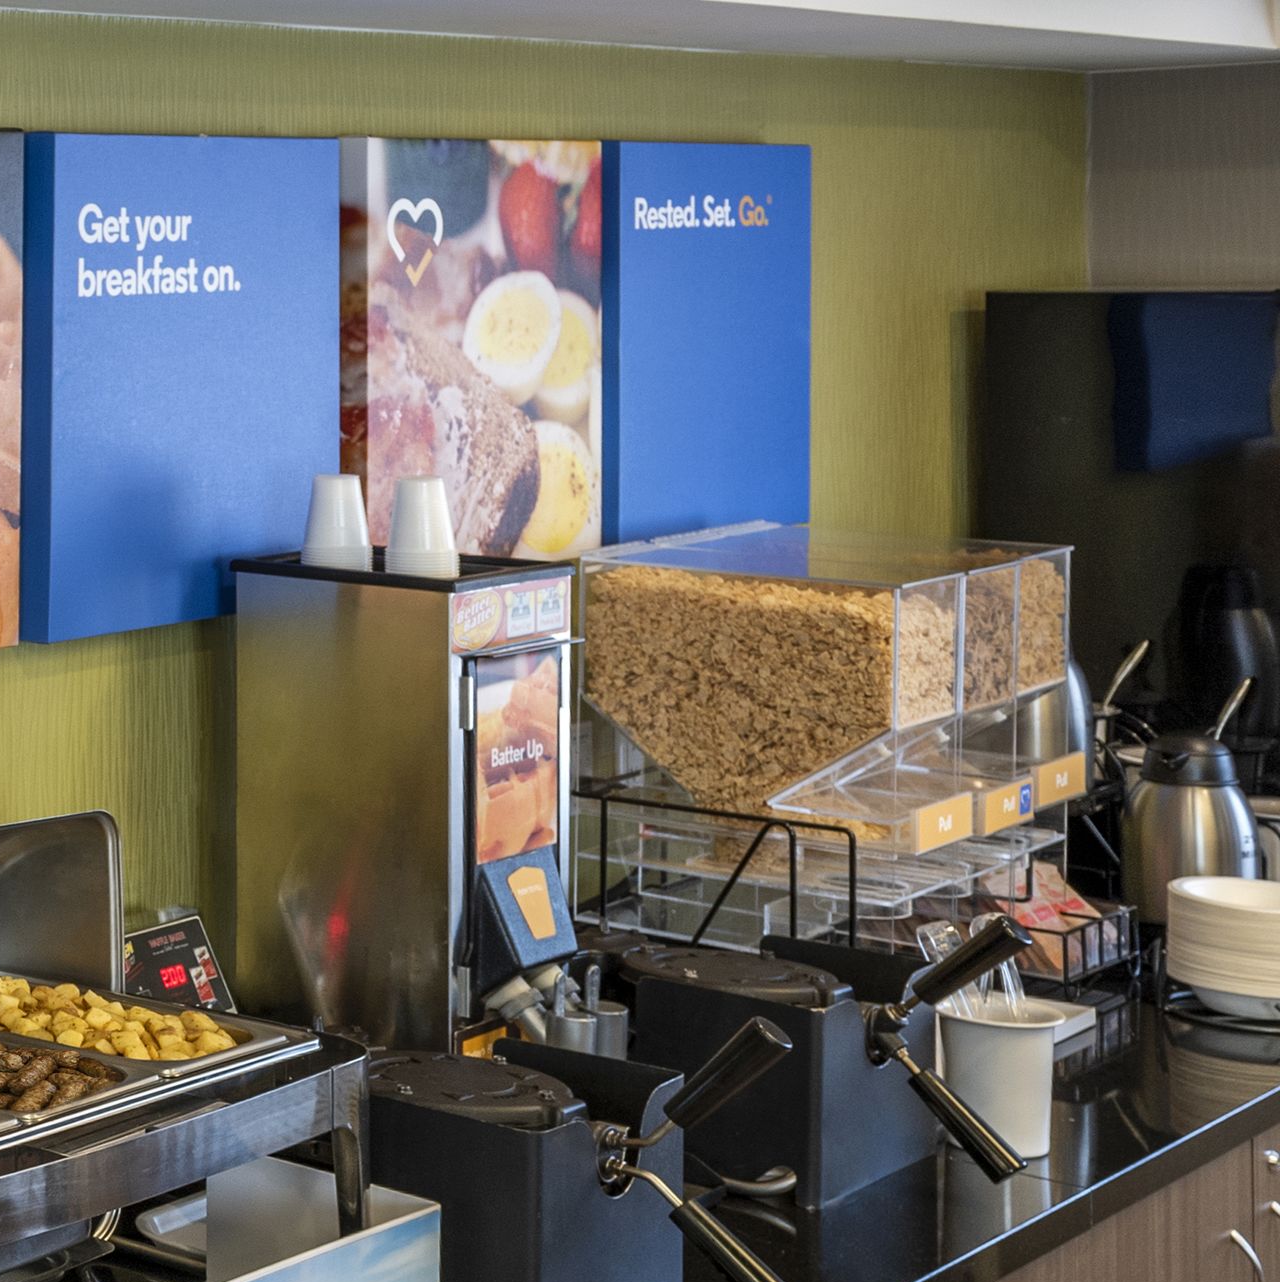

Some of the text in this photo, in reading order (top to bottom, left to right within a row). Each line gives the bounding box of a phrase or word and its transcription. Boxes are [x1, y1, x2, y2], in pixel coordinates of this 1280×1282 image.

[78, 203, 192, 251] Get your
[634, 195, 700, 229] Rested.
[703, 195, 736, 228] Set.
[77, 254, 241, 297] breakfast on.
[491, 738, 544, 768] Batter Up
[1056, 771, 1068, 788] Pull
[1003, 796, 1016, 813] Pull
[938, 814, 952, 832] Pull
